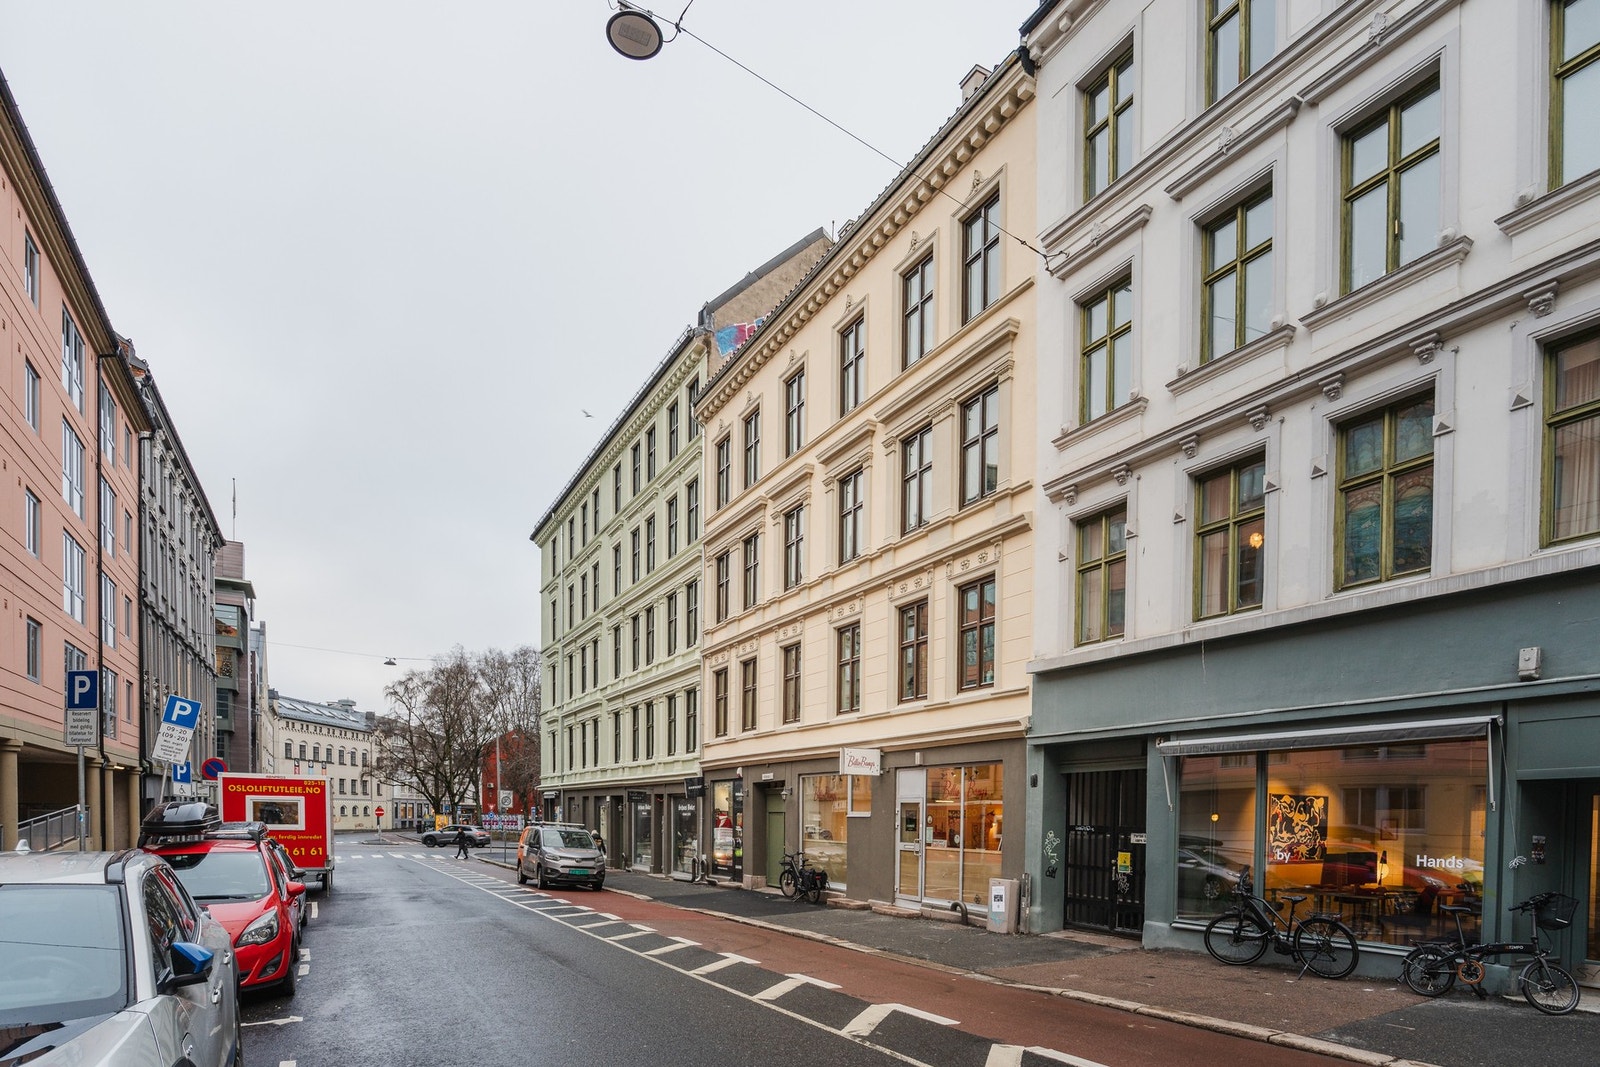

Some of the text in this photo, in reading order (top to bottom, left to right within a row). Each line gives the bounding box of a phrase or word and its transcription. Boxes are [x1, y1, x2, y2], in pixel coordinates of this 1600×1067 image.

[74, 675, 91, 705] P
[171, 700, 192, 722] P
[228, 784, 321, 794] OSLOLIFTUTLEIE.NO
[293, 847, 305, 856] 61
[310, 847, 322, 856] 61
[1277, 849, 1464, 869] by Hands
